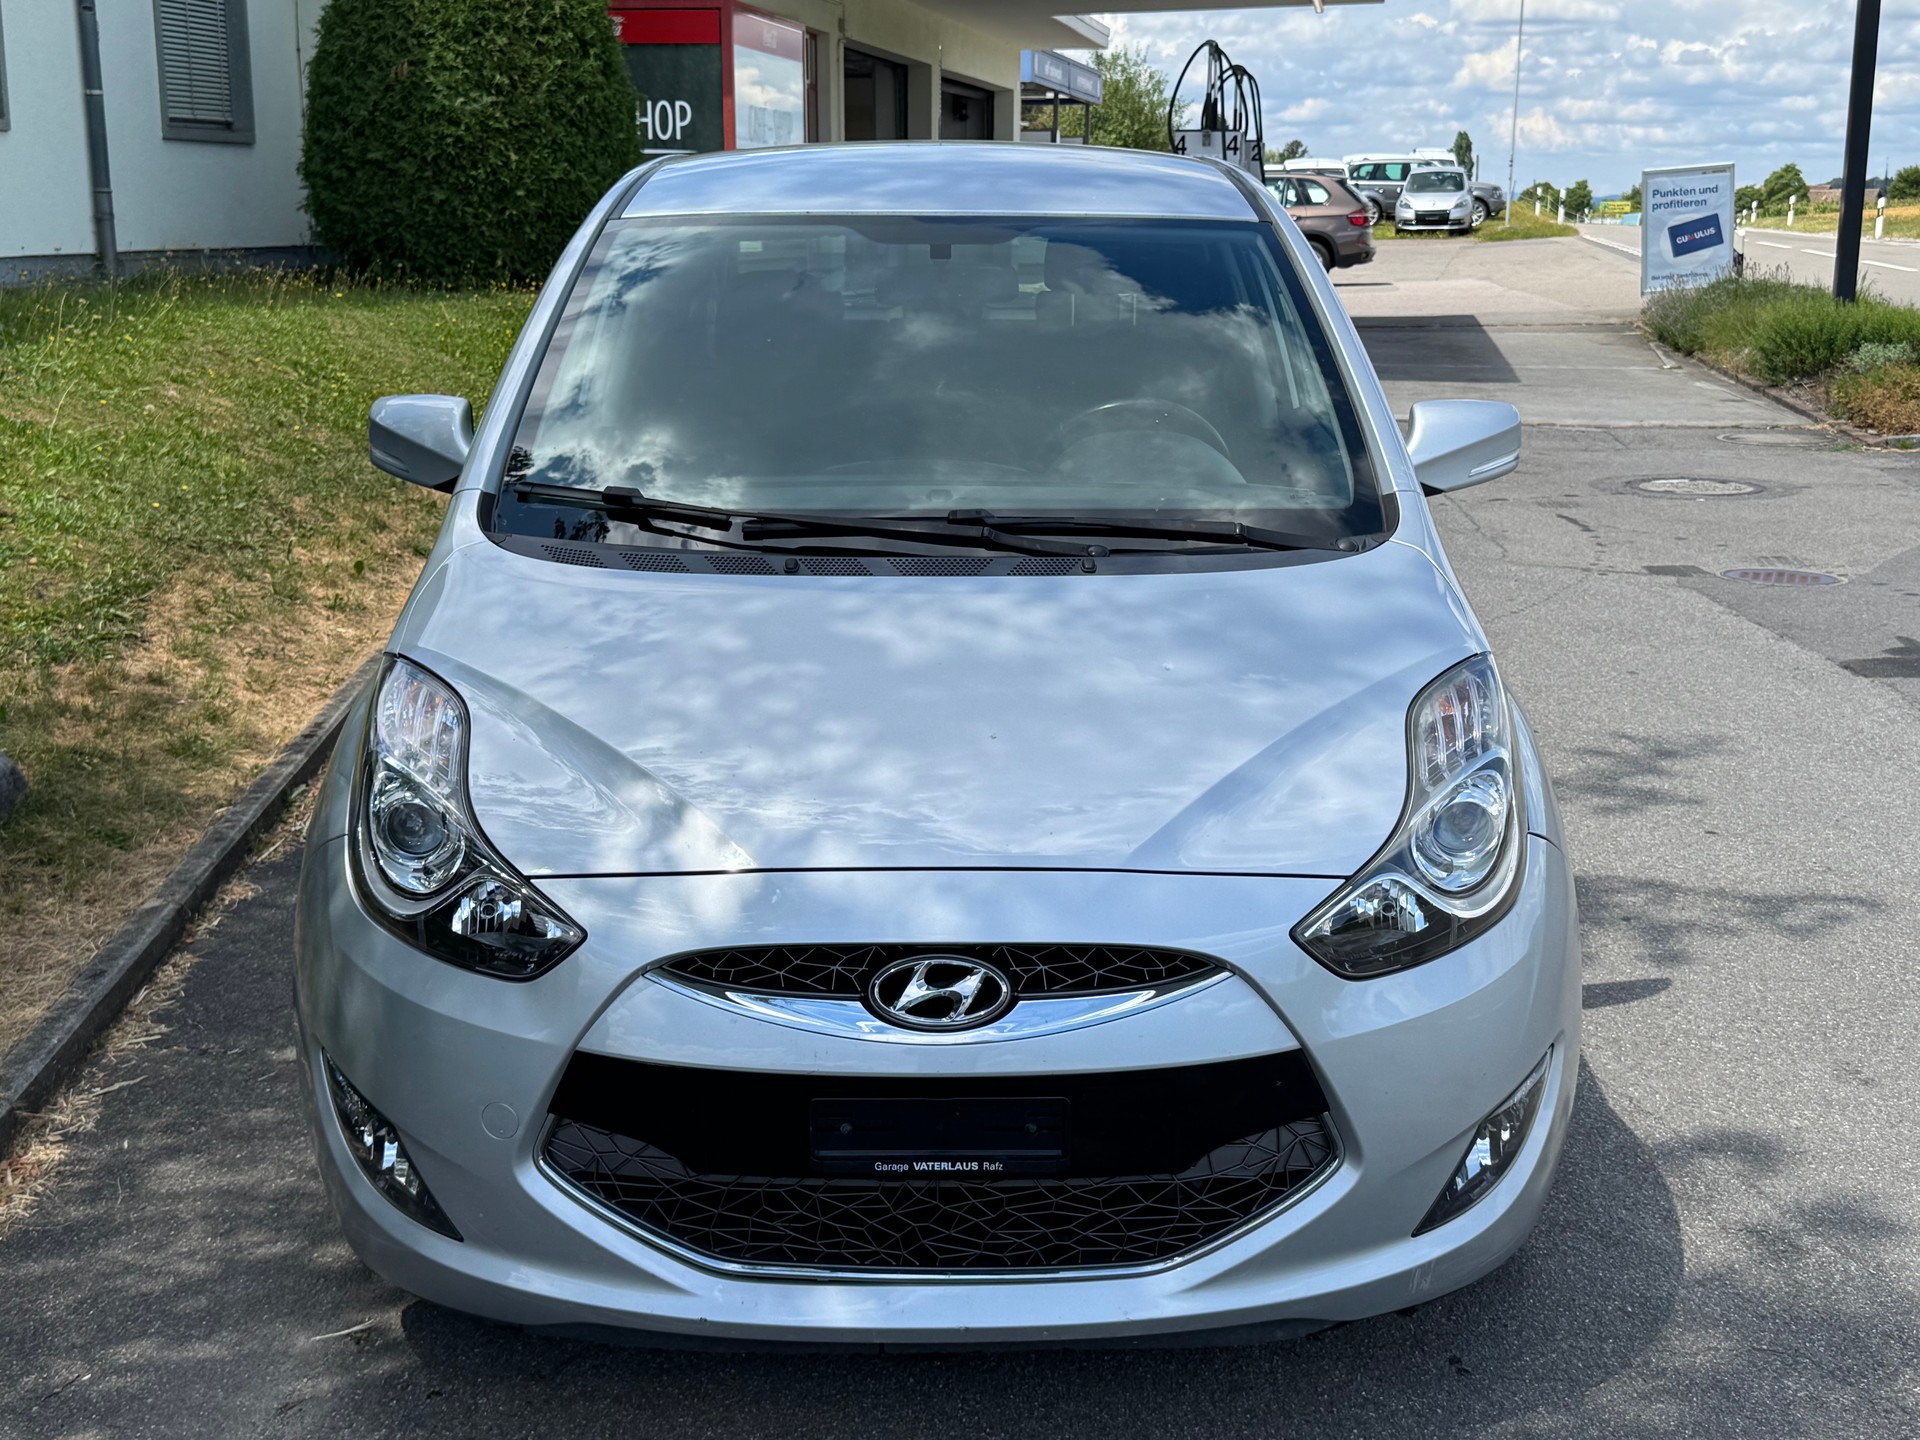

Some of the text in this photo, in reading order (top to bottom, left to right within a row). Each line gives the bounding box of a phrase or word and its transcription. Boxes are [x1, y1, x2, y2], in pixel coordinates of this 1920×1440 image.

[1175, 135, 1187, 155] 4
[1226, 135, 1239, 155] 4
[1652, 184, 1719, 199] Punkten und
[1651, 198, 1707, 212] profitieren
[1676, 227, 1716, 244] CUMULUS
[874, 1161, 1003, 1172] Garage VATERLAUS Rafz
